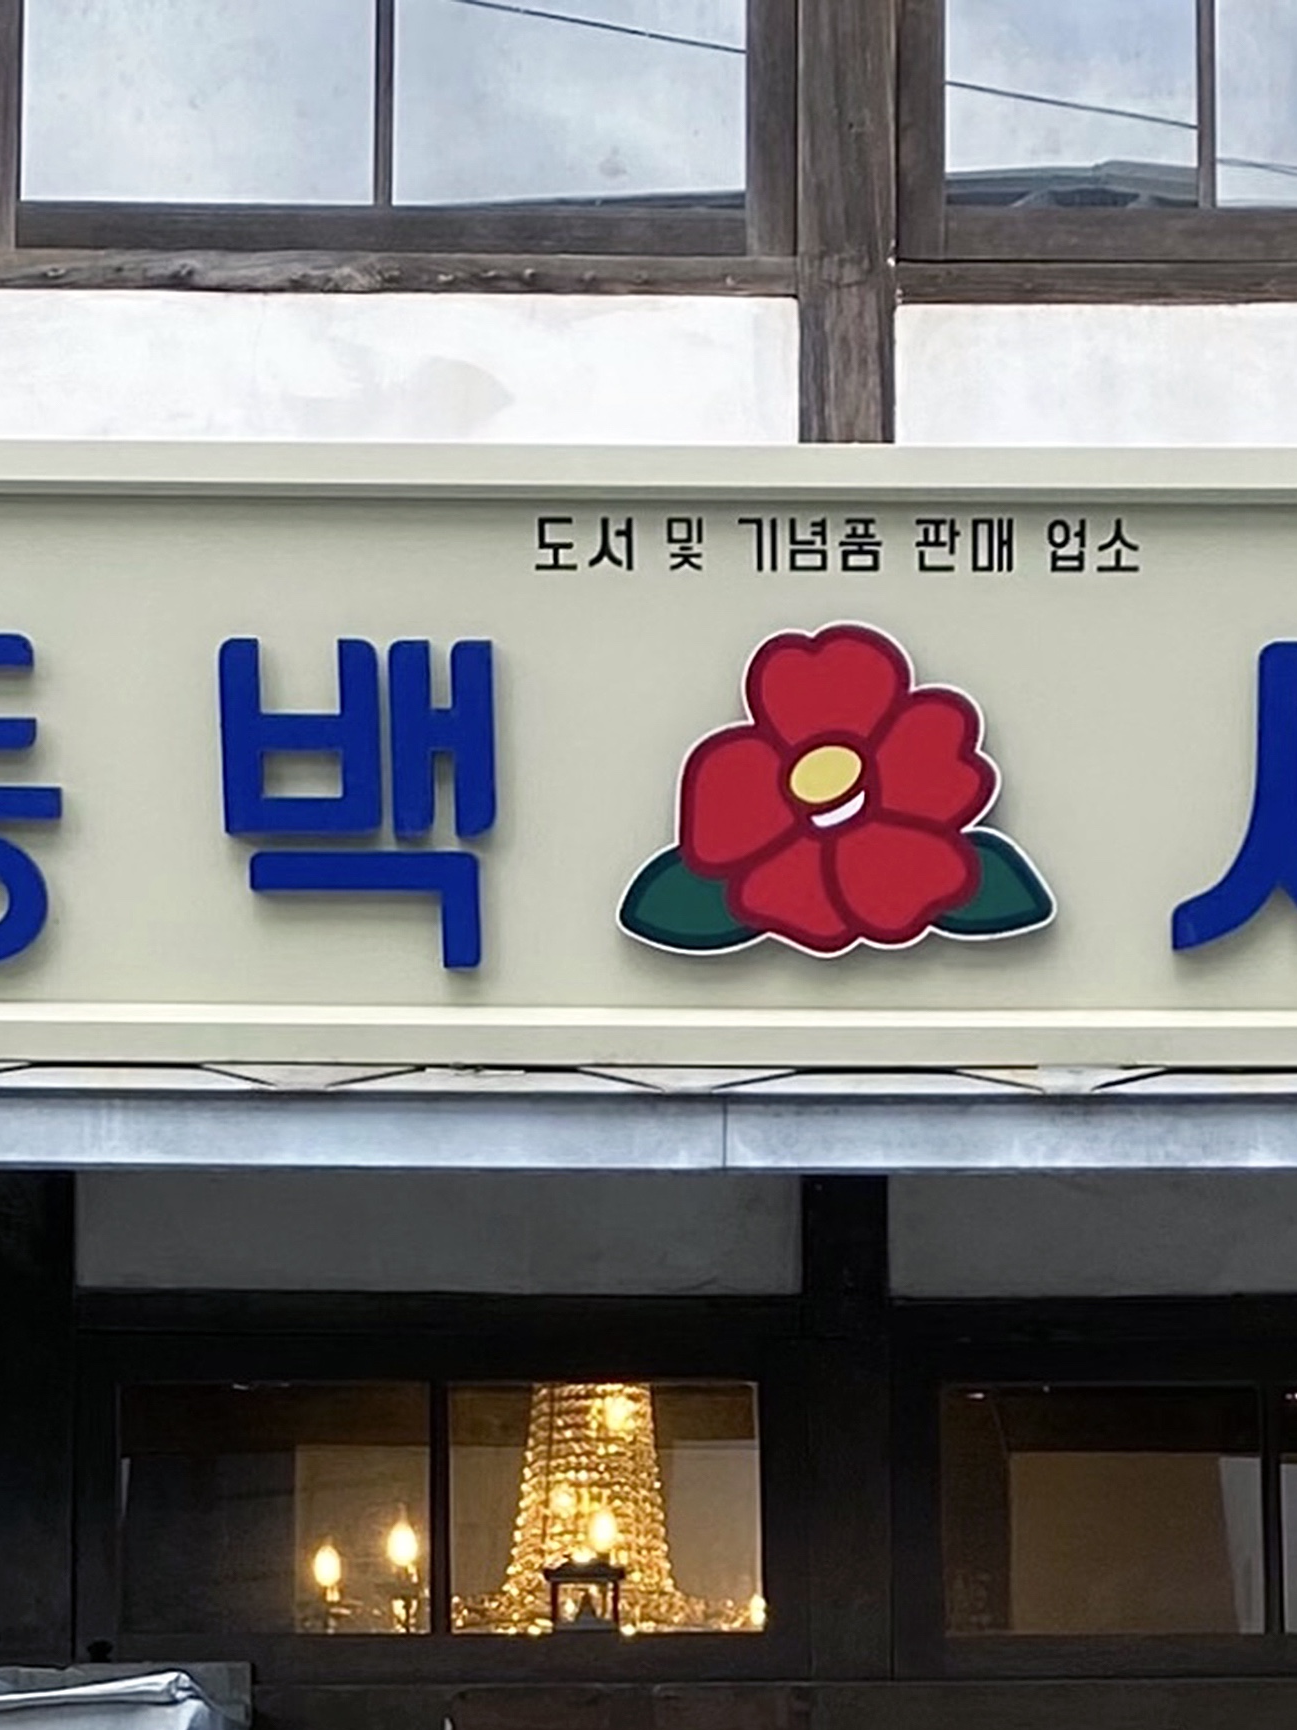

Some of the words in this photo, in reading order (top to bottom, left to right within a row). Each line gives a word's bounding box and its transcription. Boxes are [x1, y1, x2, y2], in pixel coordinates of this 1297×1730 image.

[534, 516, 635, 572] 도서
[665, 516, 704, 572] 및
[737, 516, 883, 572] 기념품
[914, 516, 1015, 573] 판매
[1046, 516, 1140, 573] 업소
